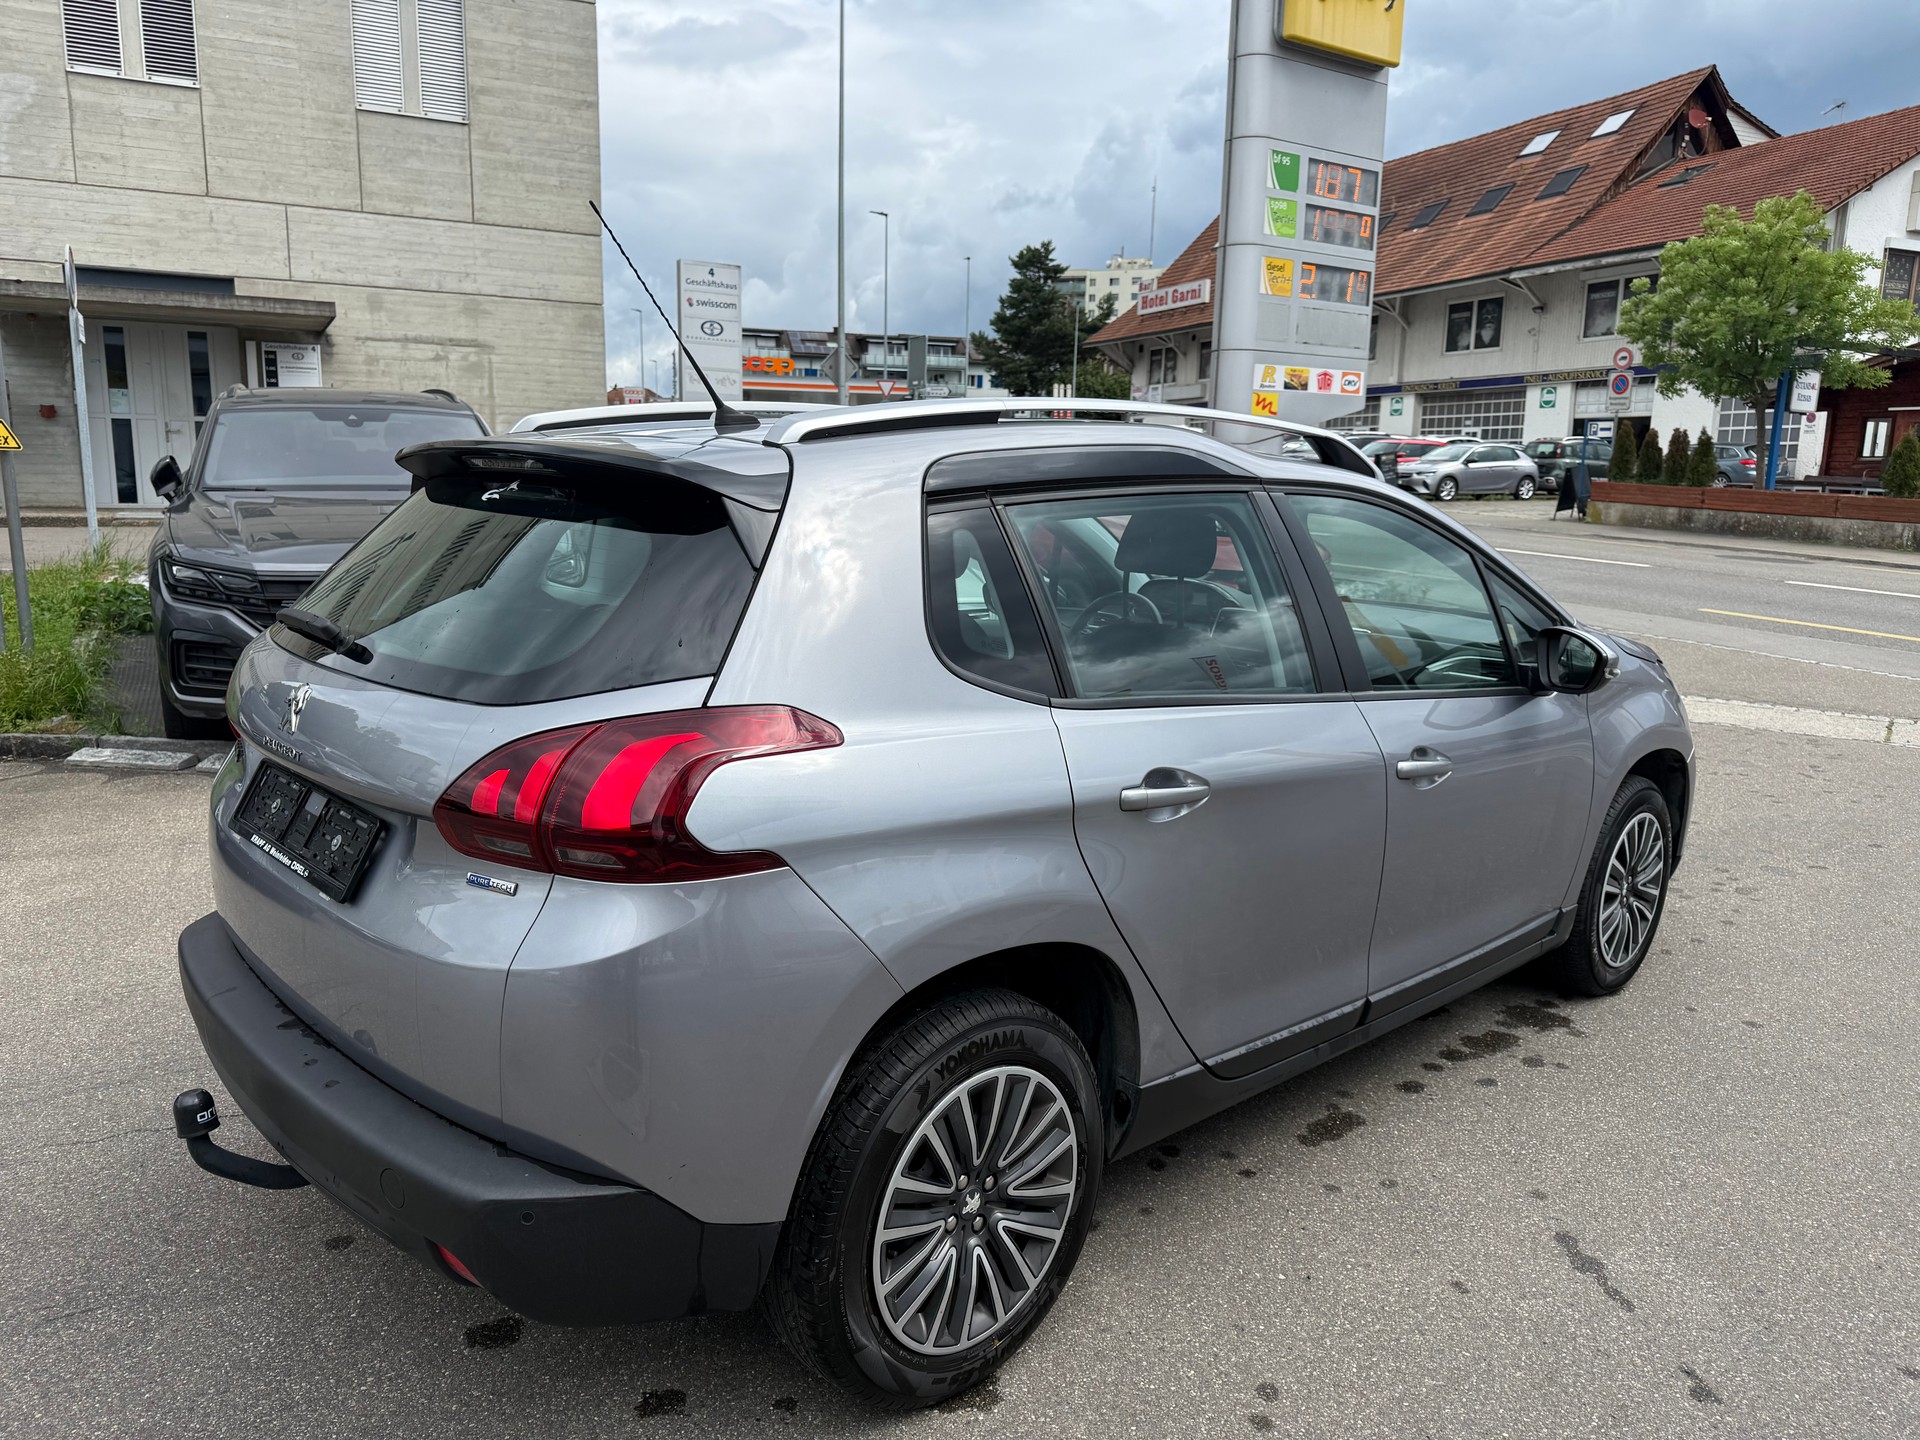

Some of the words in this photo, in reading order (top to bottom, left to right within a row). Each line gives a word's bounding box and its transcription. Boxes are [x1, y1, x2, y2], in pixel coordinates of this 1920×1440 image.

[708, 267, 715, 278] 4
[1266, 261, 1286, 273] diesel
[685, 277, 738, 290] Geschäftshaus
[695, 297, 738, 310] swisscom
[1141, 290, 1169, 311] Hotel
[1171, 283, 1202, 305] Garni
[262, 735, 303, 761] PEUGEOT
[250, 833, 267, 848] KRAPF
[262, 842, 272, 853] AG
[269, 846, 292, 867] Weinfelden
[290, 860, 305, 876] OPEL
[933, 1029, 1027, 1081] YOKOHAMA
